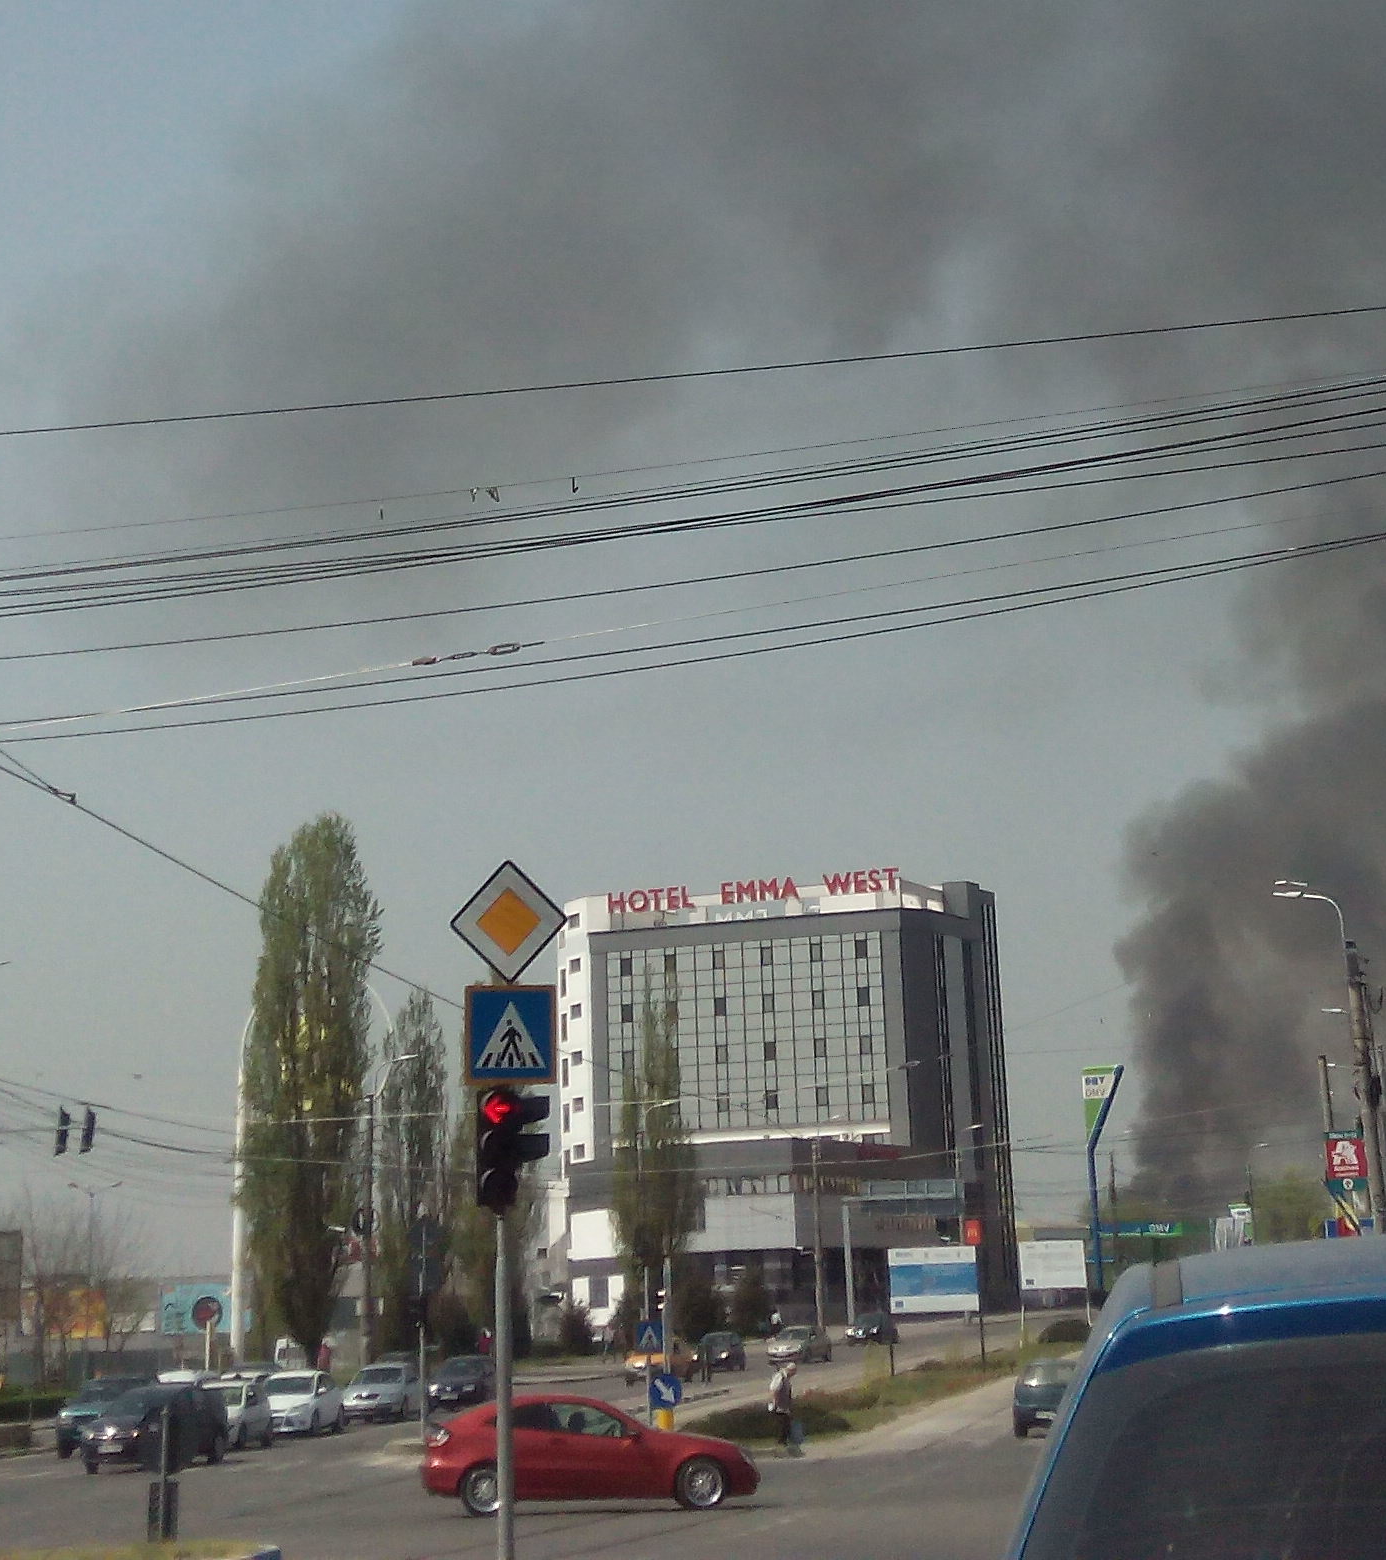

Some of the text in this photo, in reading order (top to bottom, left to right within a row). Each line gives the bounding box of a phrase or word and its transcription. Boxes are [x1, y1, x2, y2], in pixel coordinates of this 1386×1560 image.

[607, 885, 696, 915] HOTEL
[720, 876, 801, 905] EMMA
[822, 867, 900, 896] WEST
